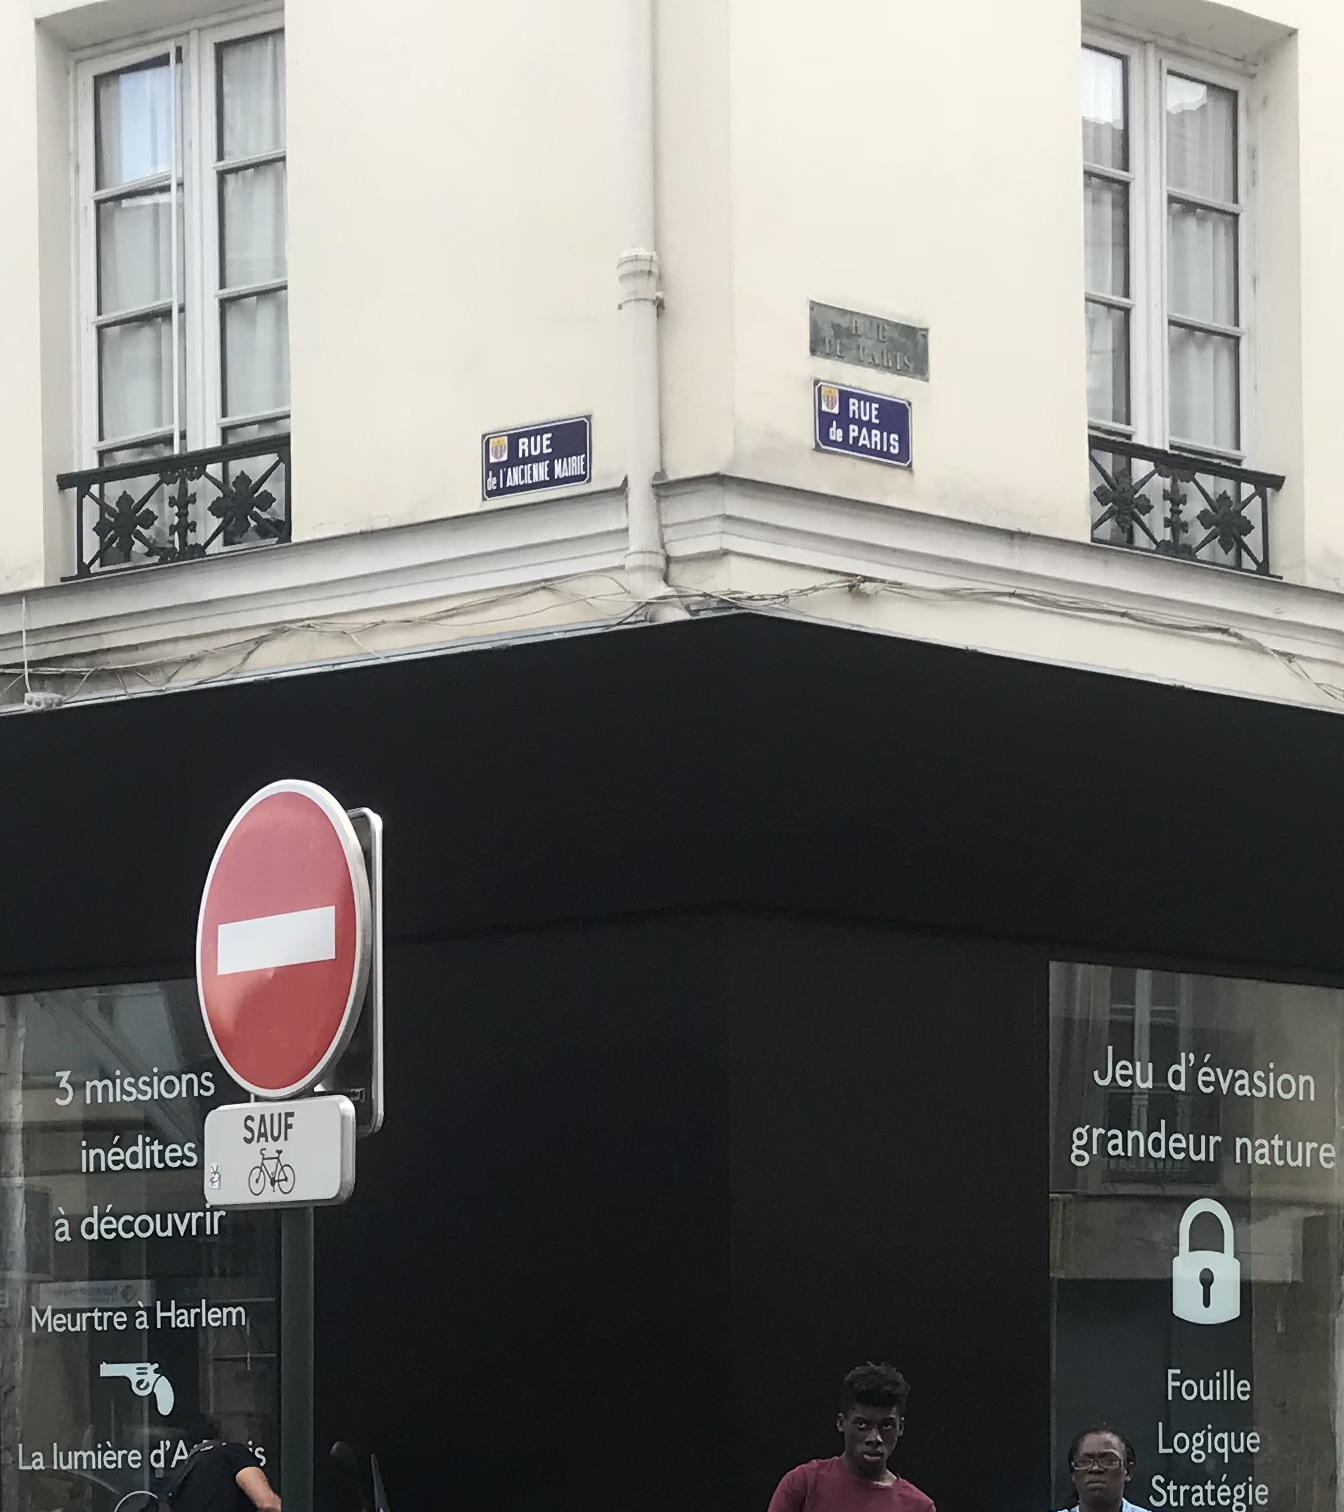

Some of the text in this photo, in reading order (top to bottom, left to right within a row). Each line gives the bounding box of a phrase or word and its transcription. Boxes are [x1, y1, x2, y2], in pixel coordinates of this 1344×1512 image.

[849, 397, 880, 424] RUE
[518, 433, 552, 458] RUE
[829, 420, 899, 454] de PARIS
[486, 454, 586, 490] de l'ANCIENNE MAIRIE
[55, 1067, 215, 1106] 3 missions
[1093, 1046, 1316, 1101] Jeu d'évasion
[243, 1111, 295, 1144] SAUF
[1070, 1119, 1336, 1169] grandeur nature
[81, 1135, 197, 1173] inédites
[55, 1203, 226, 1242] à découvrir
[30, 1299, 246, 1333] Meurtre à Harlem
[1167, 1367, 1251, 1402] Fouille
[18, 1443, 45, 1470] La
[53, 1441, 142, 1470] lumière
[1158, 1423, 1260, 1462] Logique
